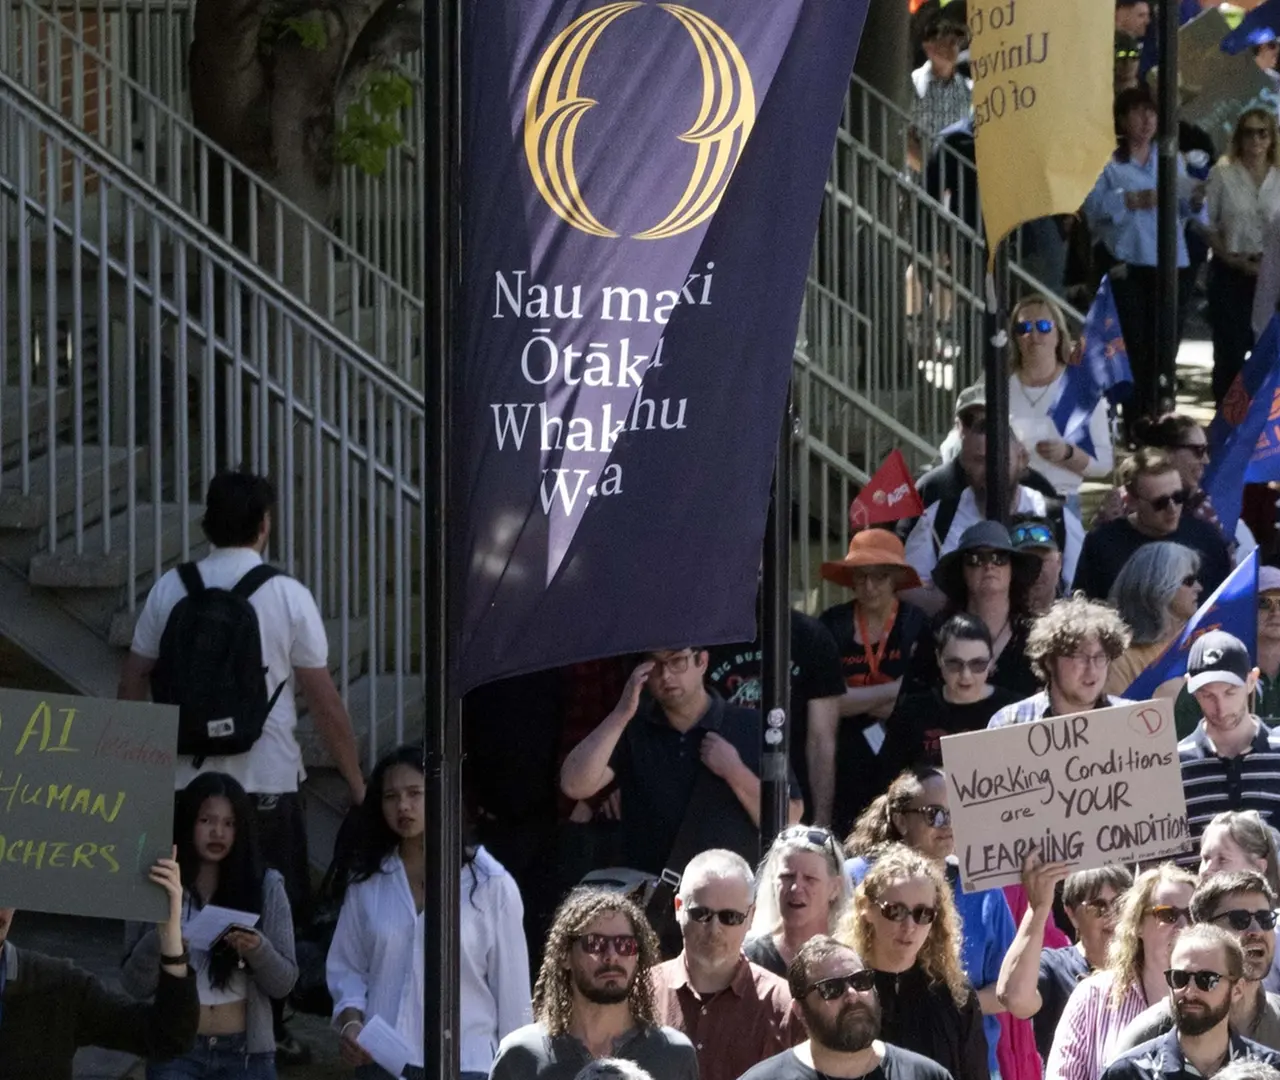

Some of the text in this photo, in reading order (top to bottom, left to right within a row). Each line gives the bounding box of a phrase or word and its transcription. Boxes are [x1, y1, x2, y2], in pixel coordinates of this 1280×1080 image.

[492, 270, 584, 319] Nau
[15, 701, 80, 756] AI
[1027, 716, 1090, 757] OUR
[1065, 750, 1173, 783] Conditions
[1000, 781, 1133, 823] are YOUR
